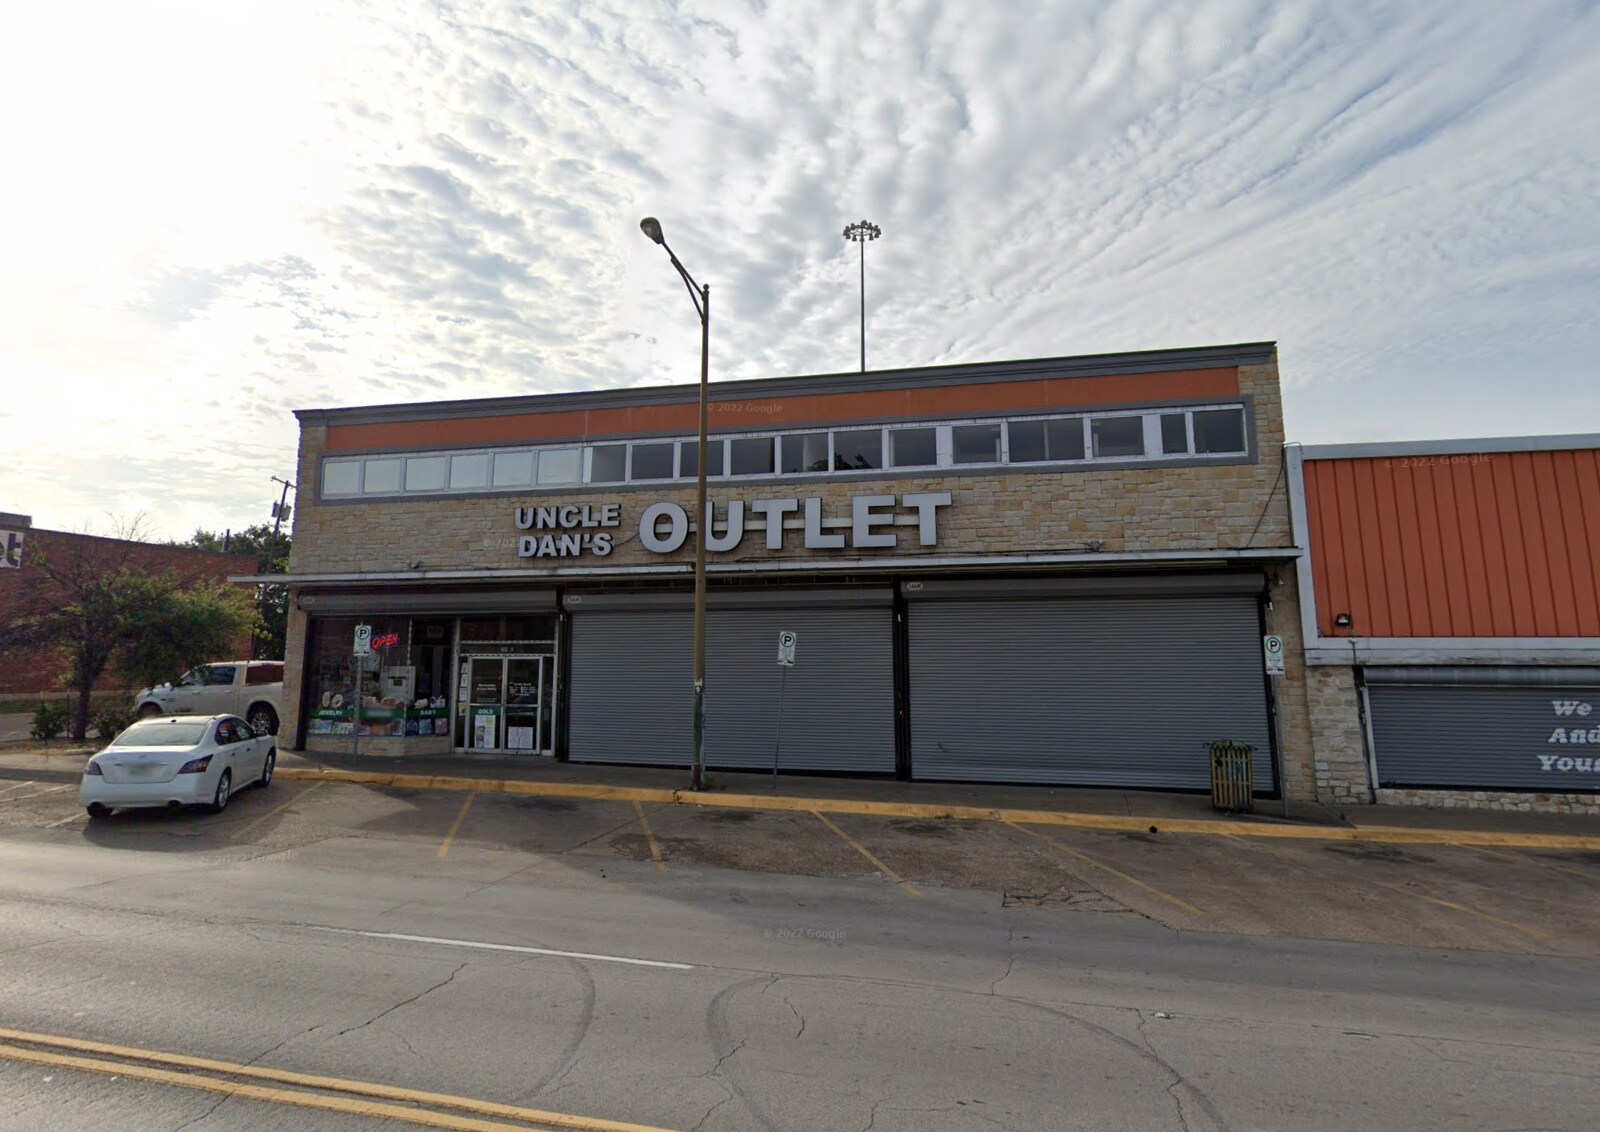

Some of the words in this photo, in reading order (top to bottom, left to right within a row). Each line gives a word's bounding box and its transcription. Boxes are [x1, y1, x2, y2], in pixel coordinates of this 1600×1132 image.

[514, 503, 621, 530] UNCLE
[639, 491, 952, 554] OUTLET
[518, 532, 614, 558] DAN'S
[371, 633, 398, 649] OPEN
[1551, 700, 1593, 716] We
[1547, 725, 1600, 744] And
